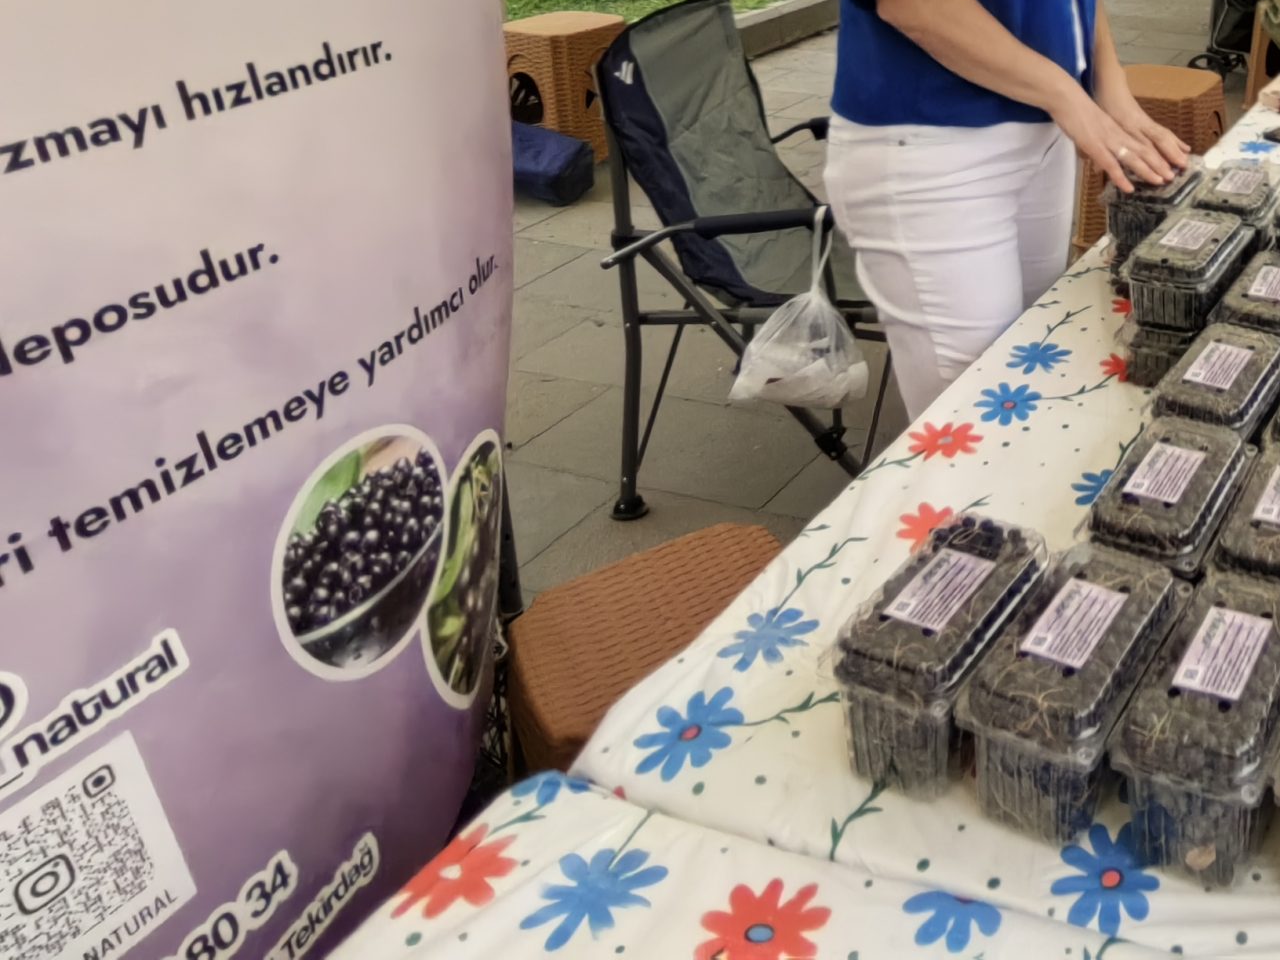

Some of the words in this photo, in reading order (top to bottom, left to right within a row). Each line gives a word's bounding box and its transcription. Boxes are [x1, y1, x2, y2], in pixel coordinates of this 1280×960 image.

[0, 103, 167, 174] zmayı
[176, 40, 393, 121] hızlandırır.
[48, 370, 350, 553] temizlemeye
[357, 287, 464, 387] yardımcı
[469, 255, 499, 296] olur.
[12, 639, 178, 769] natural
[245, 860, 292, 918] 34
[280, 842, 374, 959] Tekirdağ
